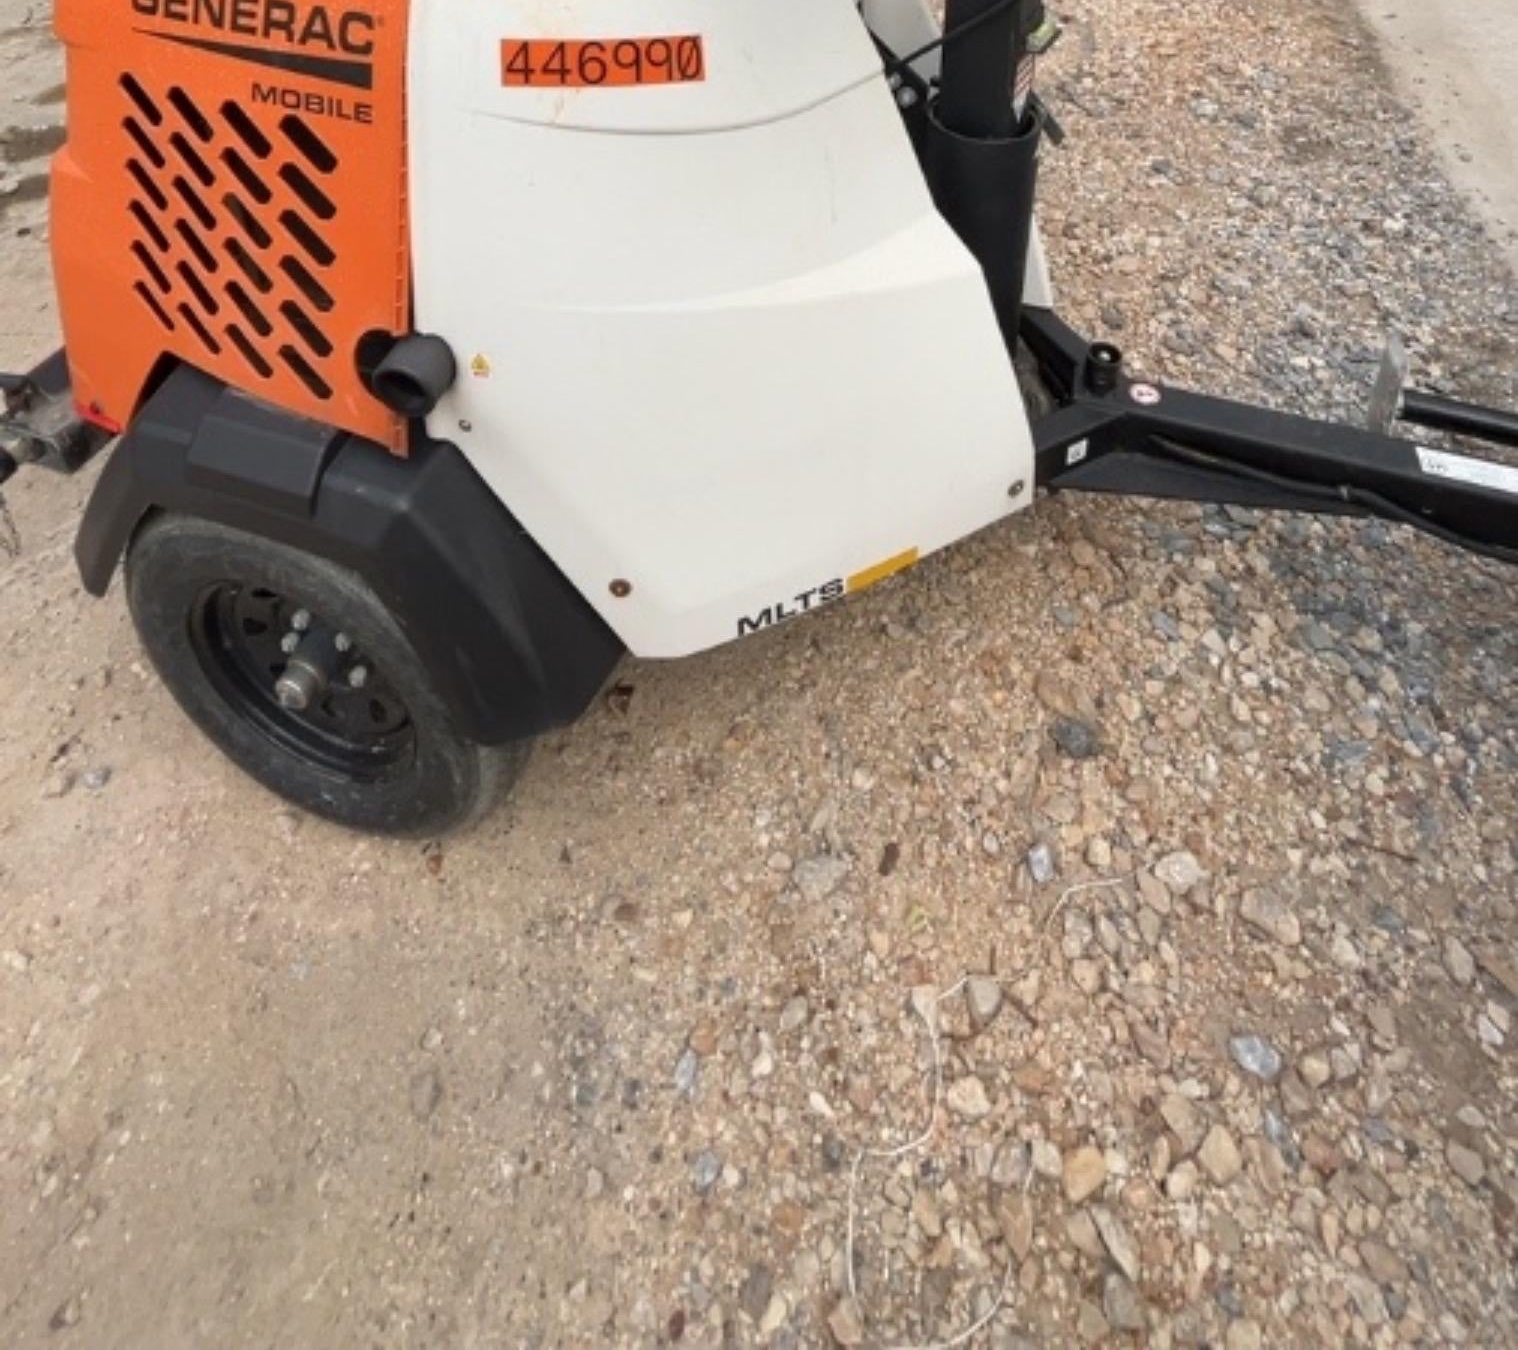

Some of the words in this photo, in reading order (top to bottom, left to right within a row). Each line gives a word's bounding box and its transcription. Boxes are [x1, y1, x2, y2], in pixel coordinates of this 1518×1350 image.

[505, 36, 701, 85] 446990
[251, 82, 373, 125] MOBILE
[737, 578, 844, 637] MLTS
